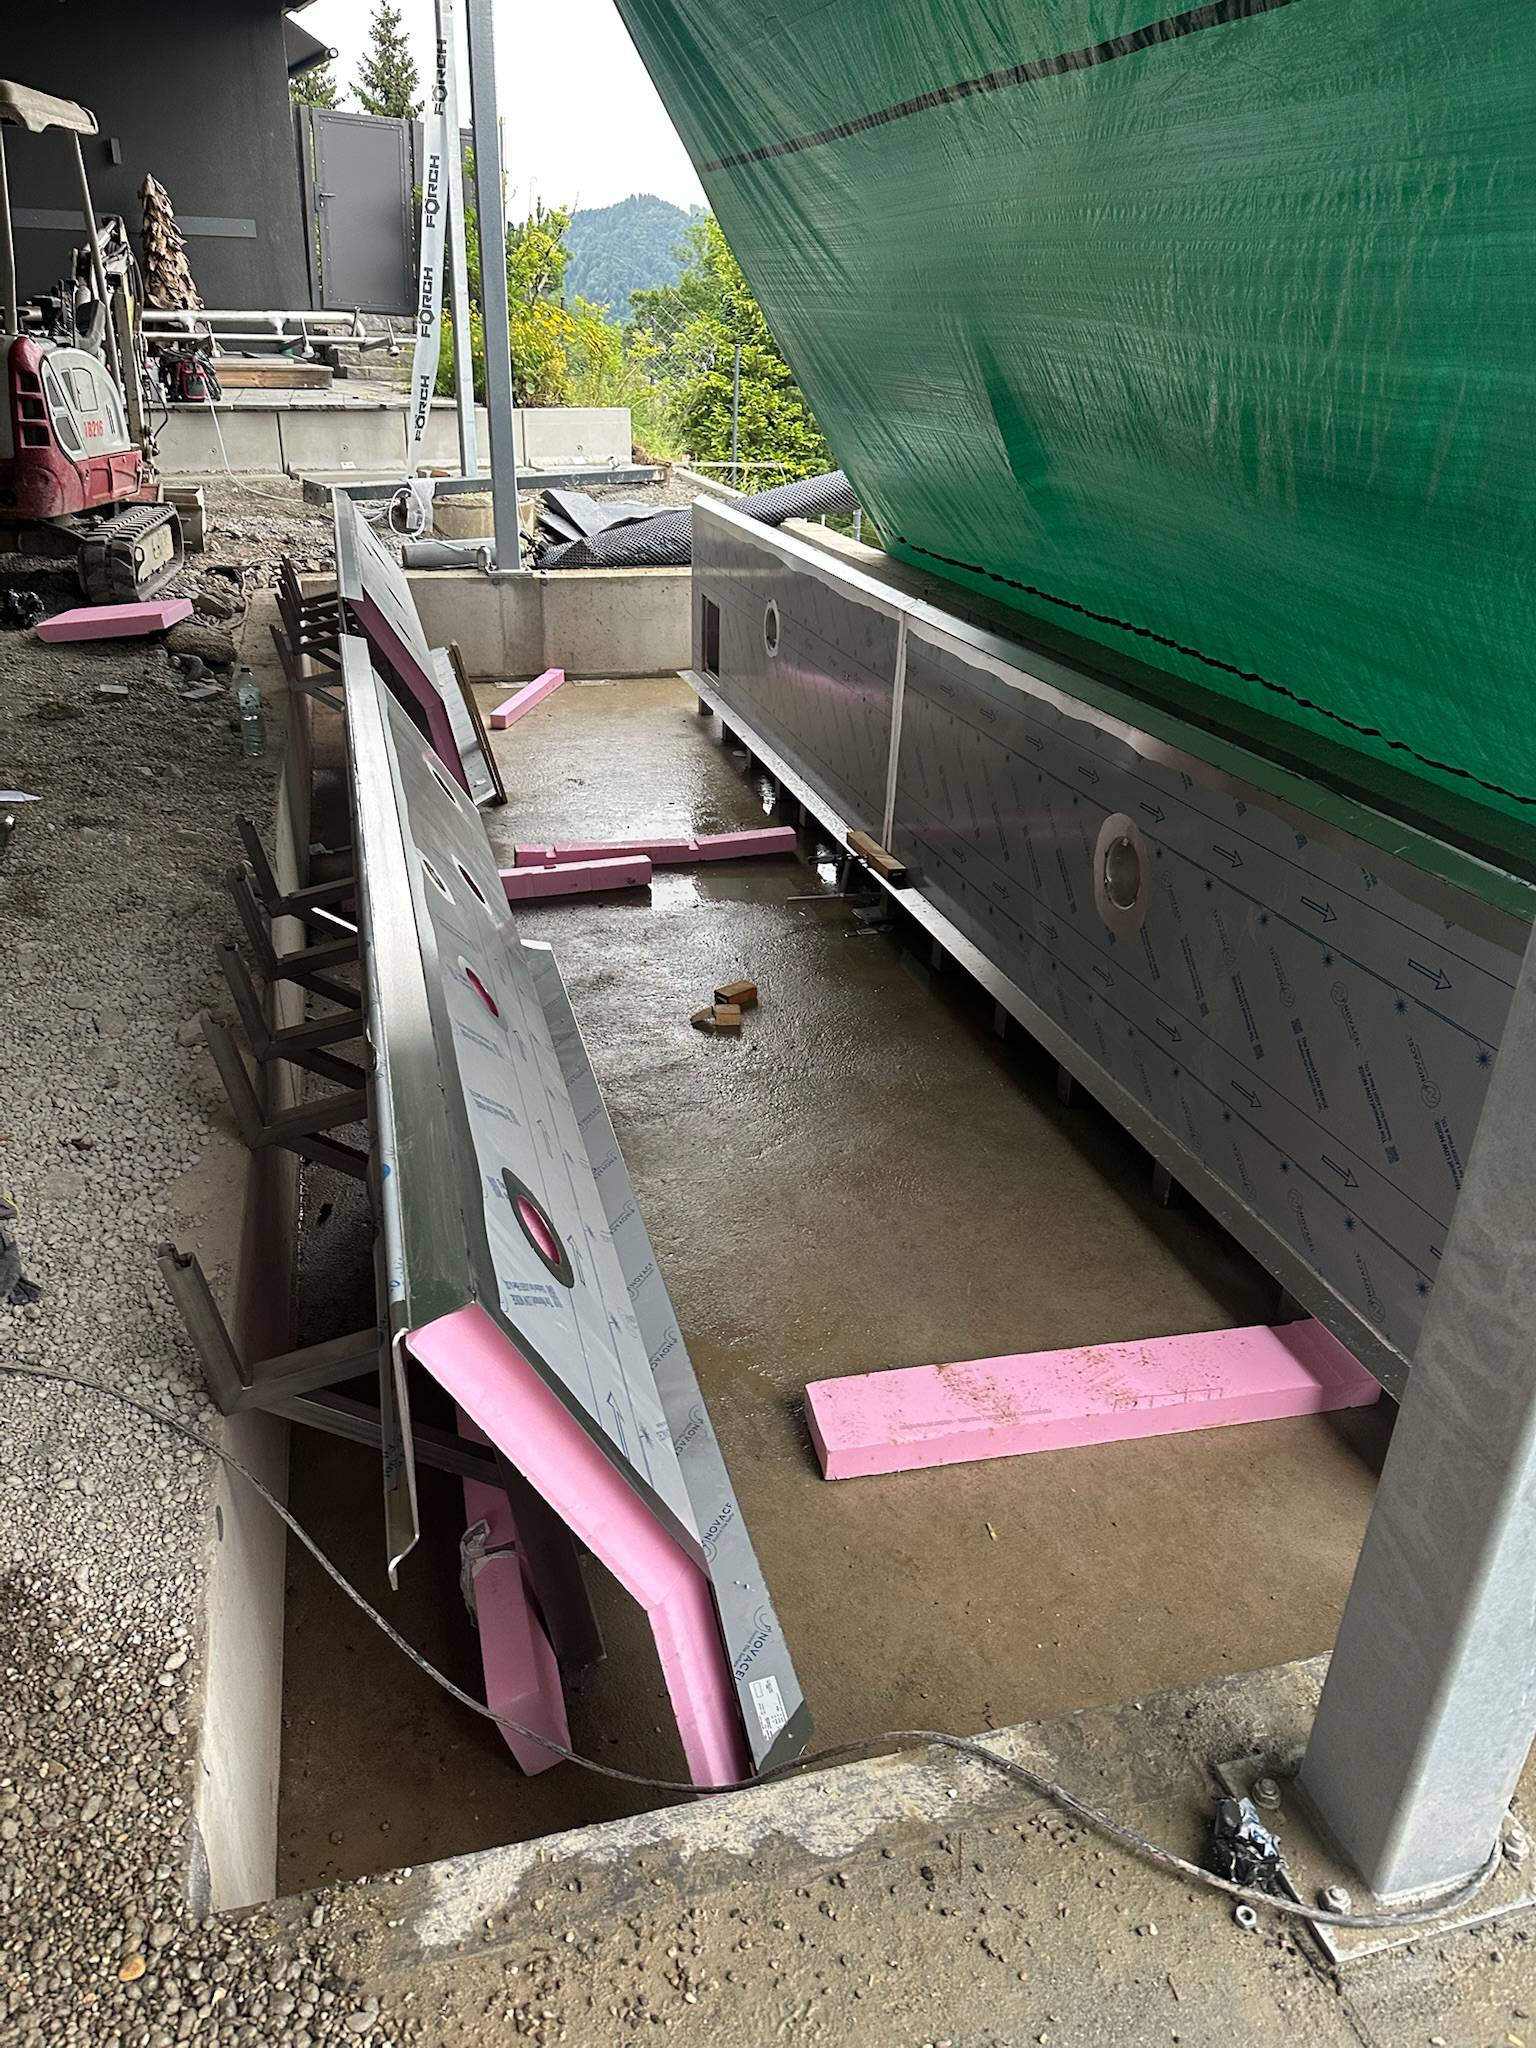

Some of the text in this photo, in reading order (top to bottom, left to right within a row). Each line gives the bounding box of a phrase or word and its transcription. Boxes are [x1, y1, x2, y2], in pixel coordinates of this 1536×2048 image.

[426, 154, 441, 229] FÖRCH
[420, 266, 435, 339] FÖRCH
[630, 1262, 653, 1288] NOVAC
[651, 1341, 676, 1371] NOVAC
[675, 1422, 701, 1457] NOVAC
